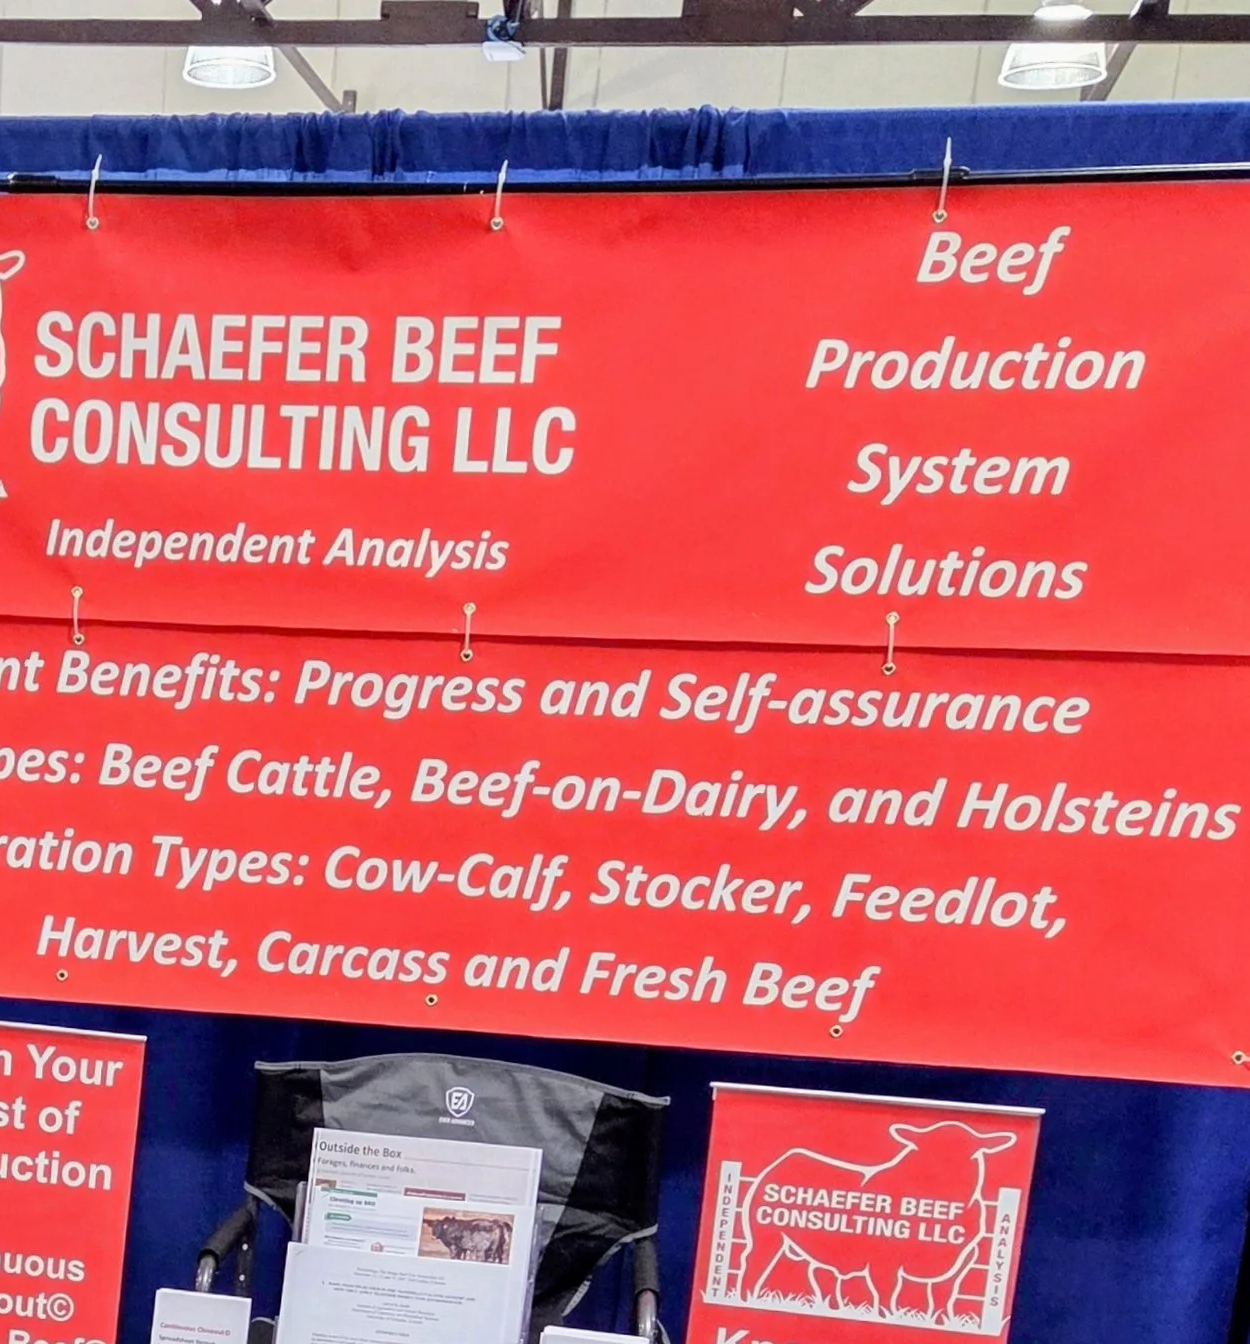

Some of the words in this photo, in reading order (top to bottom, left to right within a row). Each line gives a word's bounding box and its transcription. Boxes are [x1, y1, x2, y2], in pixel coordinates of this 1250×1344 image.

[916, 226, 1071, 295] Beef
[34, 310, 366, 382] SCHAEFER
[391, 315, 562, 384] BEEF
[805, 336, 1146, 390] Production
[30, 396, 430, 472] CONSULTING
[451, 406, 577, 476] LLC
[847, 443, 1070, 506] System
[45, 518, 314, 568] Independent
[323, 527, 509, 577] Analysis
[805, 543, 1088, 600] Solutions
[56, 650, 280, 710] Benefits:
[294, 658, 525, 721] Progress
[540, 670, 650, 718] and
[659, 672, 1090, 735] Self-assurance
[99, 741, 218, 800] Beef
[226, 749, 392, 809] Cattle,
[410, 757, 808, 832] Beef-on-Dairy,
[828, 777, 948, 827] and
[956, 782, 1242, 841] Holsteins
[151, 834, 310, 891] Types:
[324, 845, 572, 911] Cow-Calf,
[589, 859, 813, 924] Stocker,
[831, 872, 1068, 938] Feedlot,
[37, 915, 238, 978] Harvest,
[257, 931, 448, 985] Carcass
[464, 947, 569, 995] and
[580, 951, 726, 1003] Fresh
[742, 961, 880, 1022] Beef
[26, 1043, 124, 1088] Your
[38, 1100, 81, 1135] of
[319, 1141, 360, 1155] Outside
[362, 1146, 380, 1157] the
[382, 1149, 402, 1159] Box
[349, 1160, 380, 1171] finances
[381, 1164, 395, 1173] and
[756, 1205, 911, 1239] CONSULTING
[917, 1222, 965, 1246] LLC
[763, 1183, 892, 1214] SCHAEFER
[900, 1197, 964, 1221] BEEF
[711, 1172, 734, 1298] INDEPENDENT
[989, 1213, 1011, 1308] ANALYSIS
